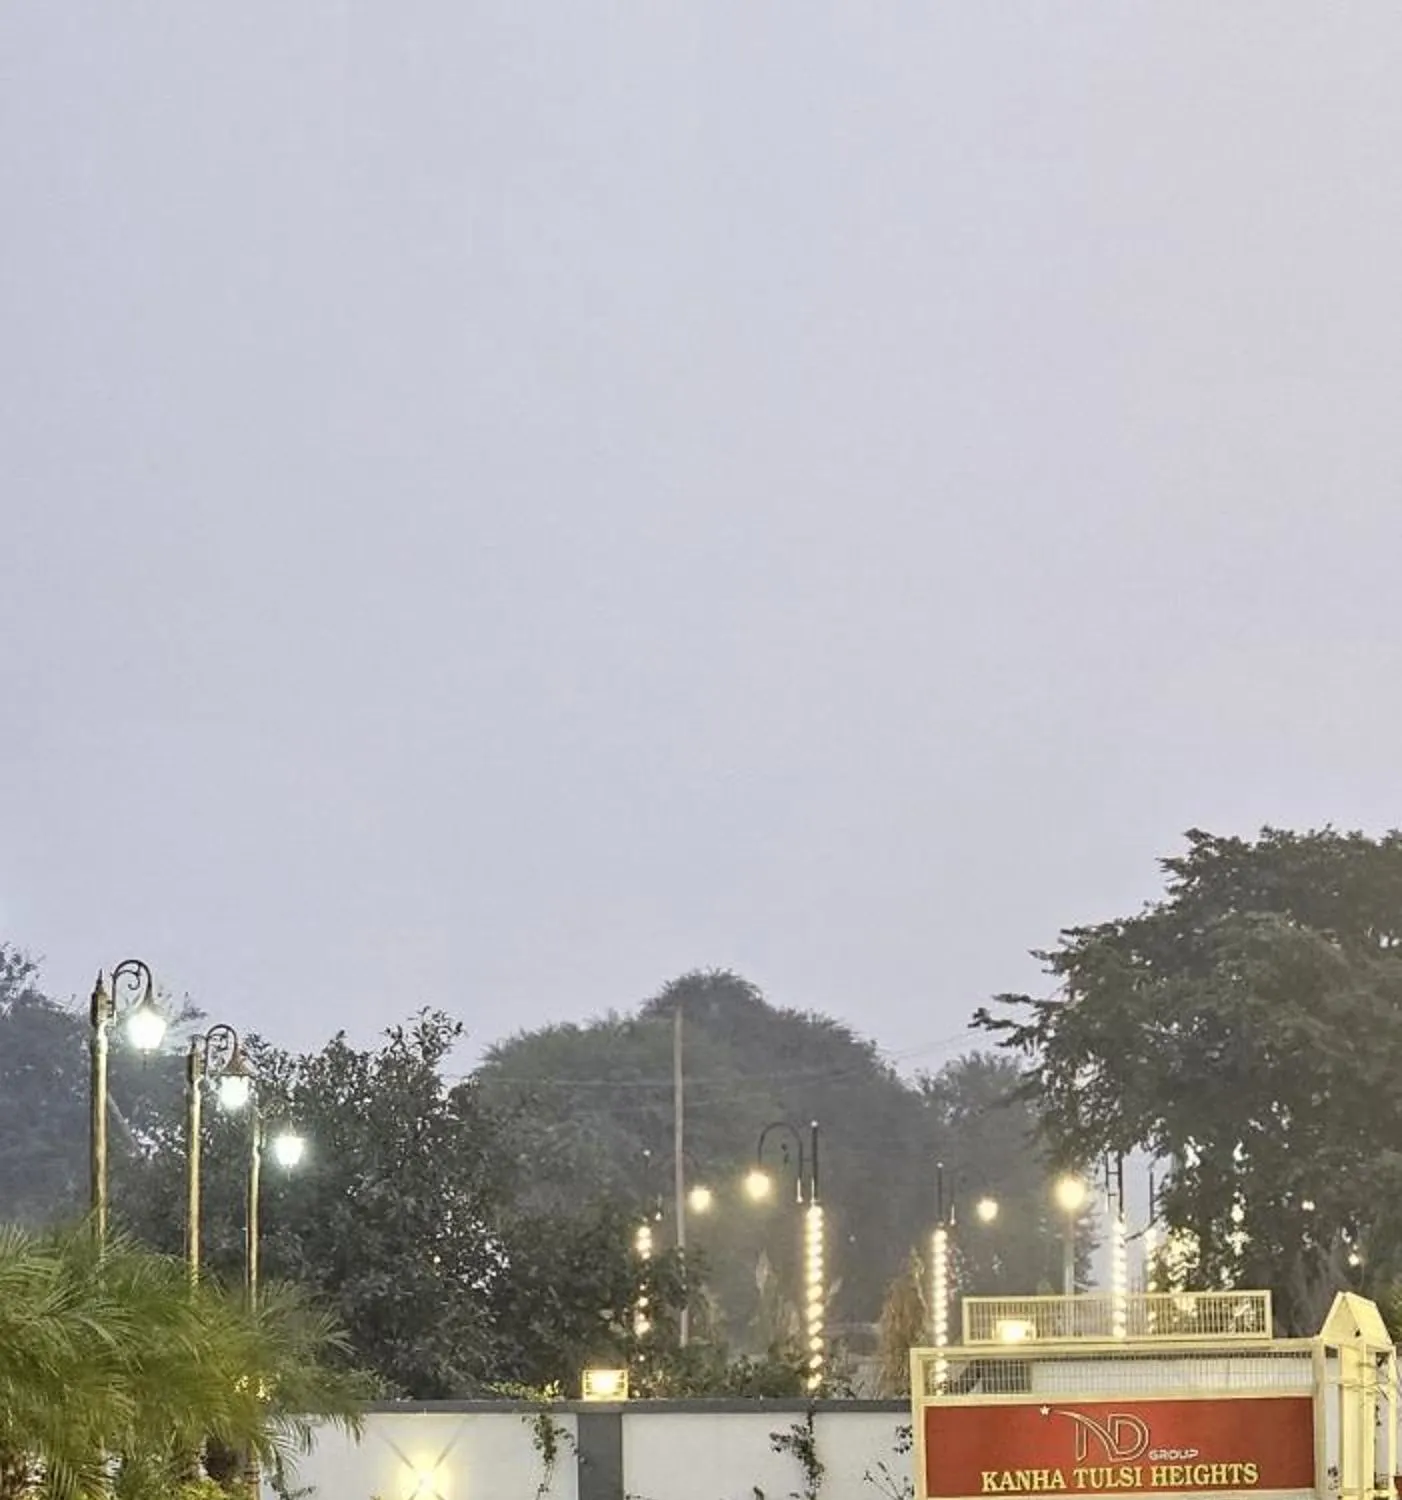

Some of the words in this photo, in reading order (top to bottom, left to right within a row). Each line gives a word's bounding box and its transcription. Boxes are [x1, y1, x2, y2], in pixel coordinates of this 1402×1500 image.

[1070, 1411, 1150, 1462] ND
[1149, 1448, 1199, 1461] GROUP
[981, 1469, 1067, 1492] KANHA
[1073, 1466, 1143, 1489] TULSI
[1150, 1462, 1259, 1487] HEIGHTS
